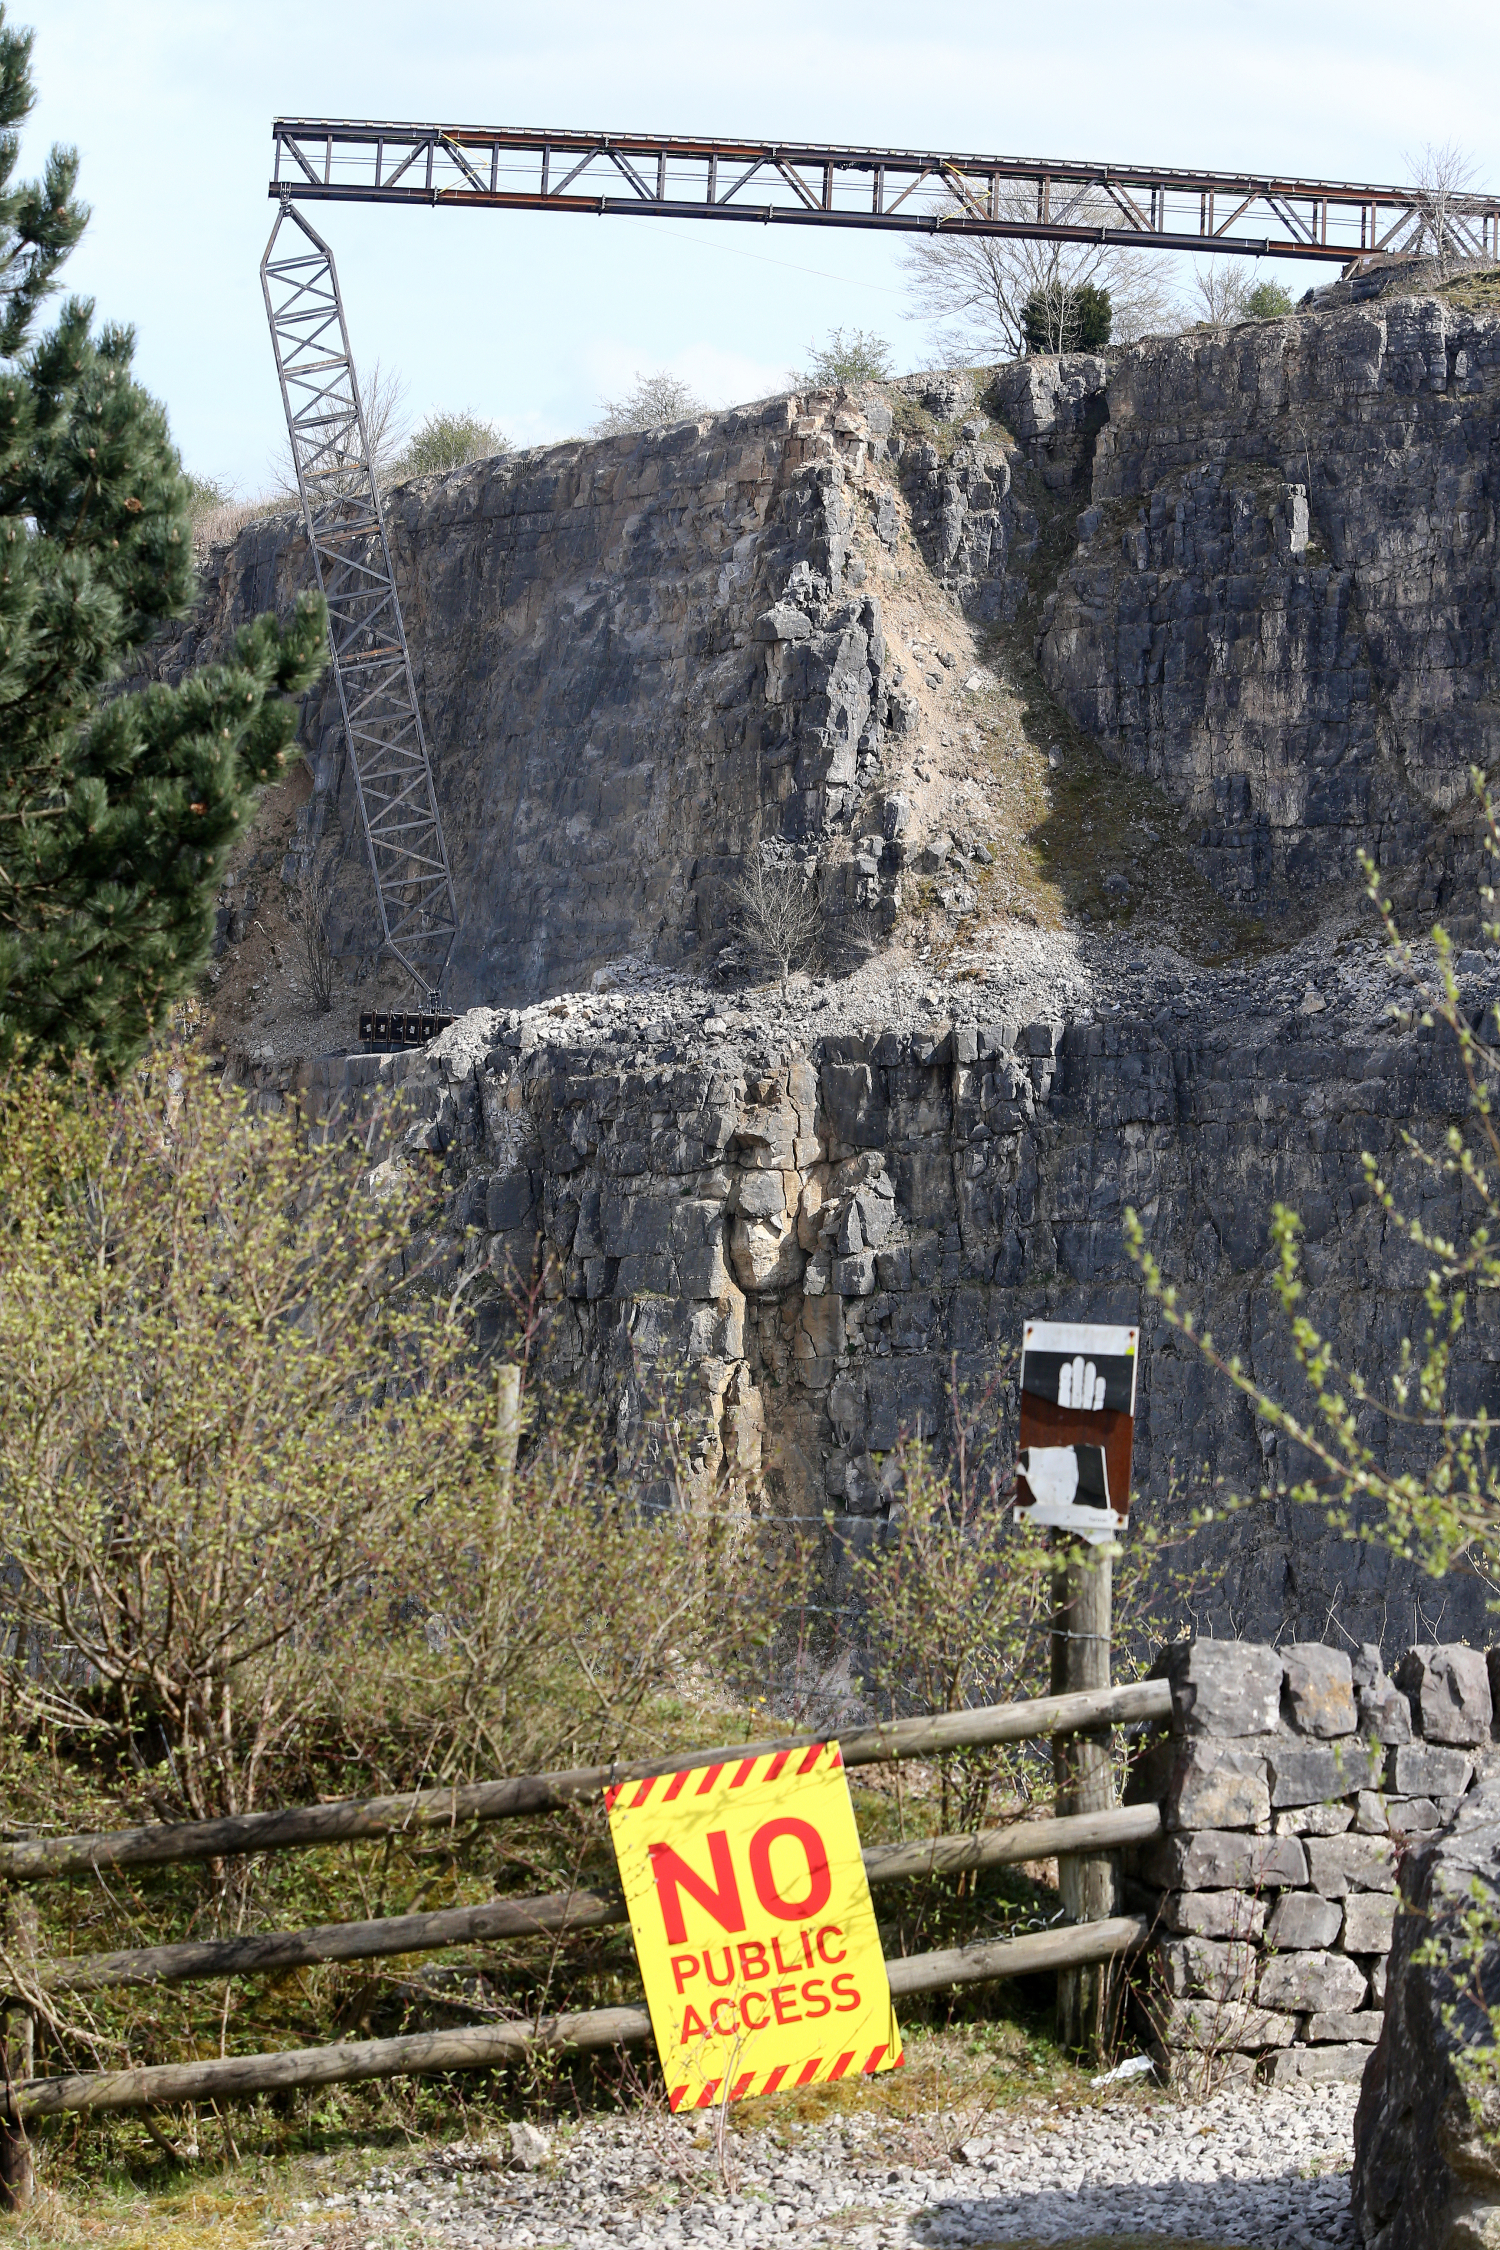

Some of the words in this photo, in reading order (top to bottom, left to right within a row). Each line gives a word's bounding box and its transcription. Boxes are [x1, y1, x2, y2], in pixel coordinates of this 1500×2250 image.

[648, 1817, 832, 1945] NO
[670, 1926, 847, 1994] PUBLIC
[680, 1973, 861, 2044] ACCESS
